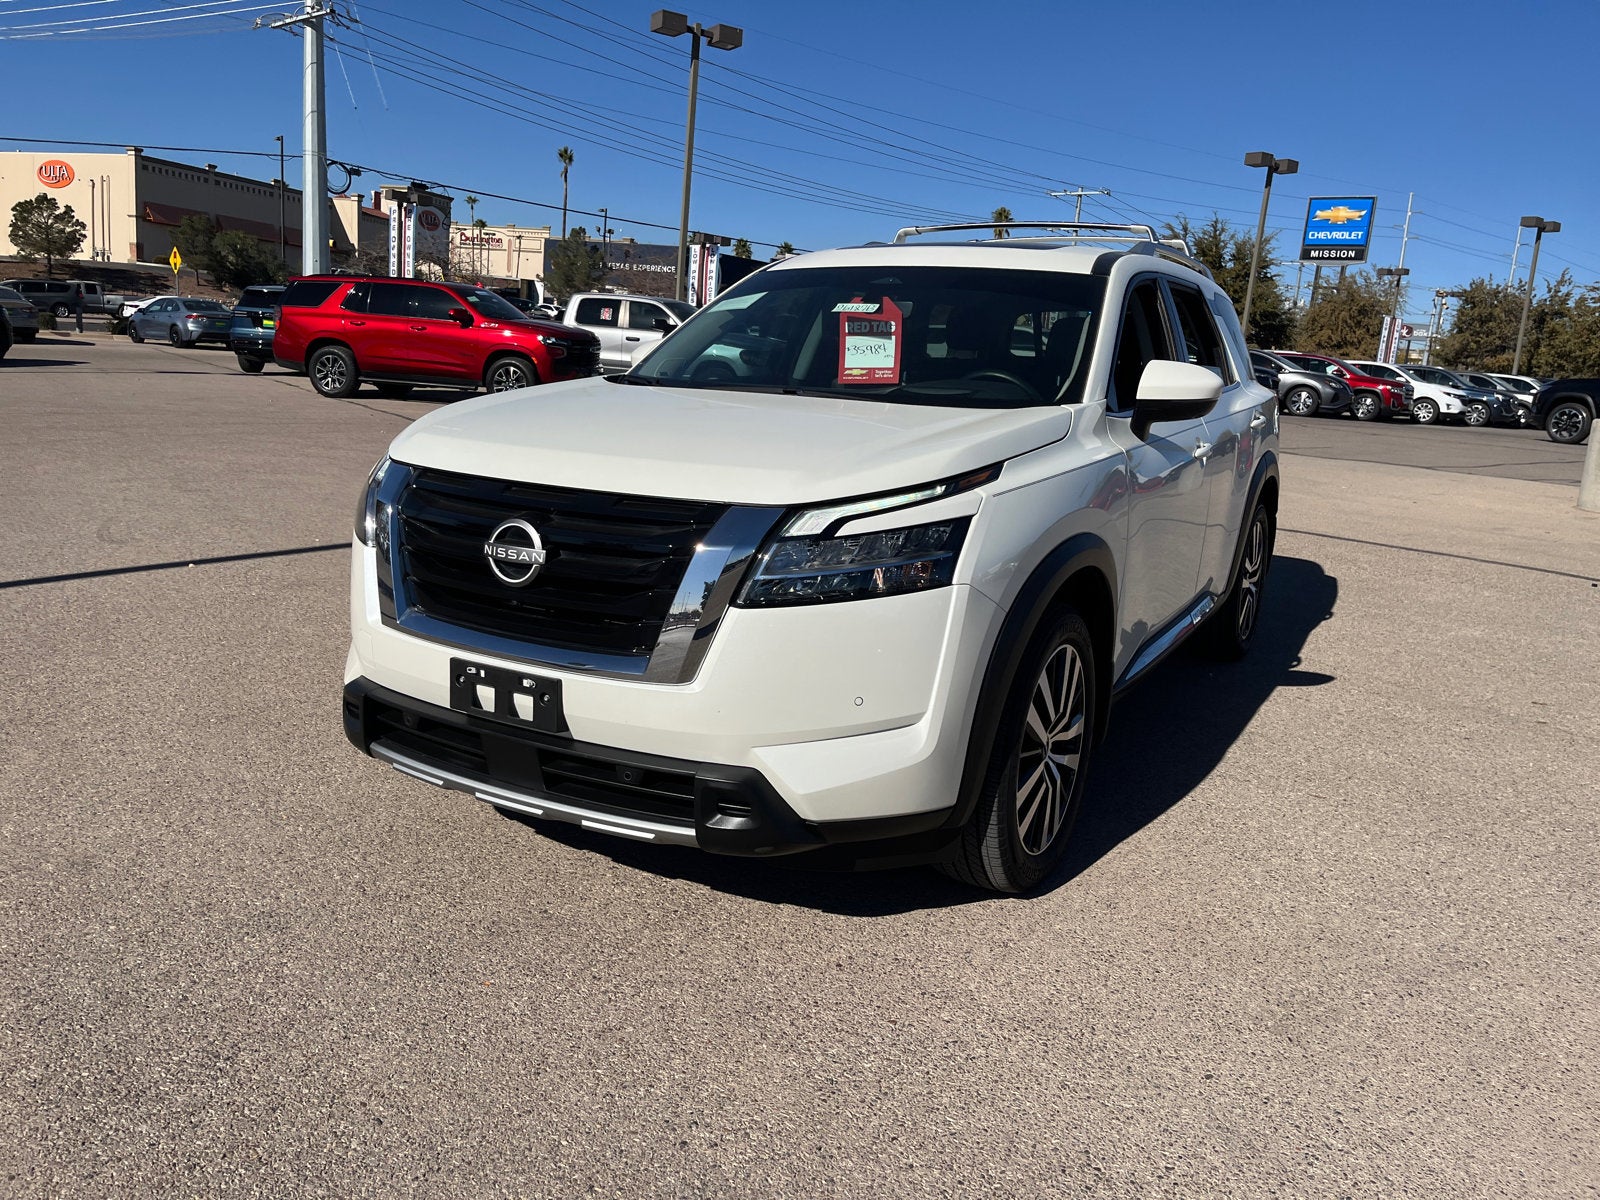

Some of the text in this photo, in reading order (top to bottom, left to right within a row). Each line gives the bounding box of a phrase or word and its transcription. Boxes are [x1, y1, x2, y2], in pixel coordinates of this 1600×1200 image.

[41, 165, 69, 177] ULTA
[460, 232, 503, 244] Burlngton
[1308, 231, 1364, 240] CHEVROLET
[1310, 250, 1356, 258] MISSION
[608, 262, 630, 271] TEXAS
[632, 263, 676, 273] EXPERIENCE
[845, 321, 896, 334] RED TAG
[484, 544, 544, 563] NISSAN
